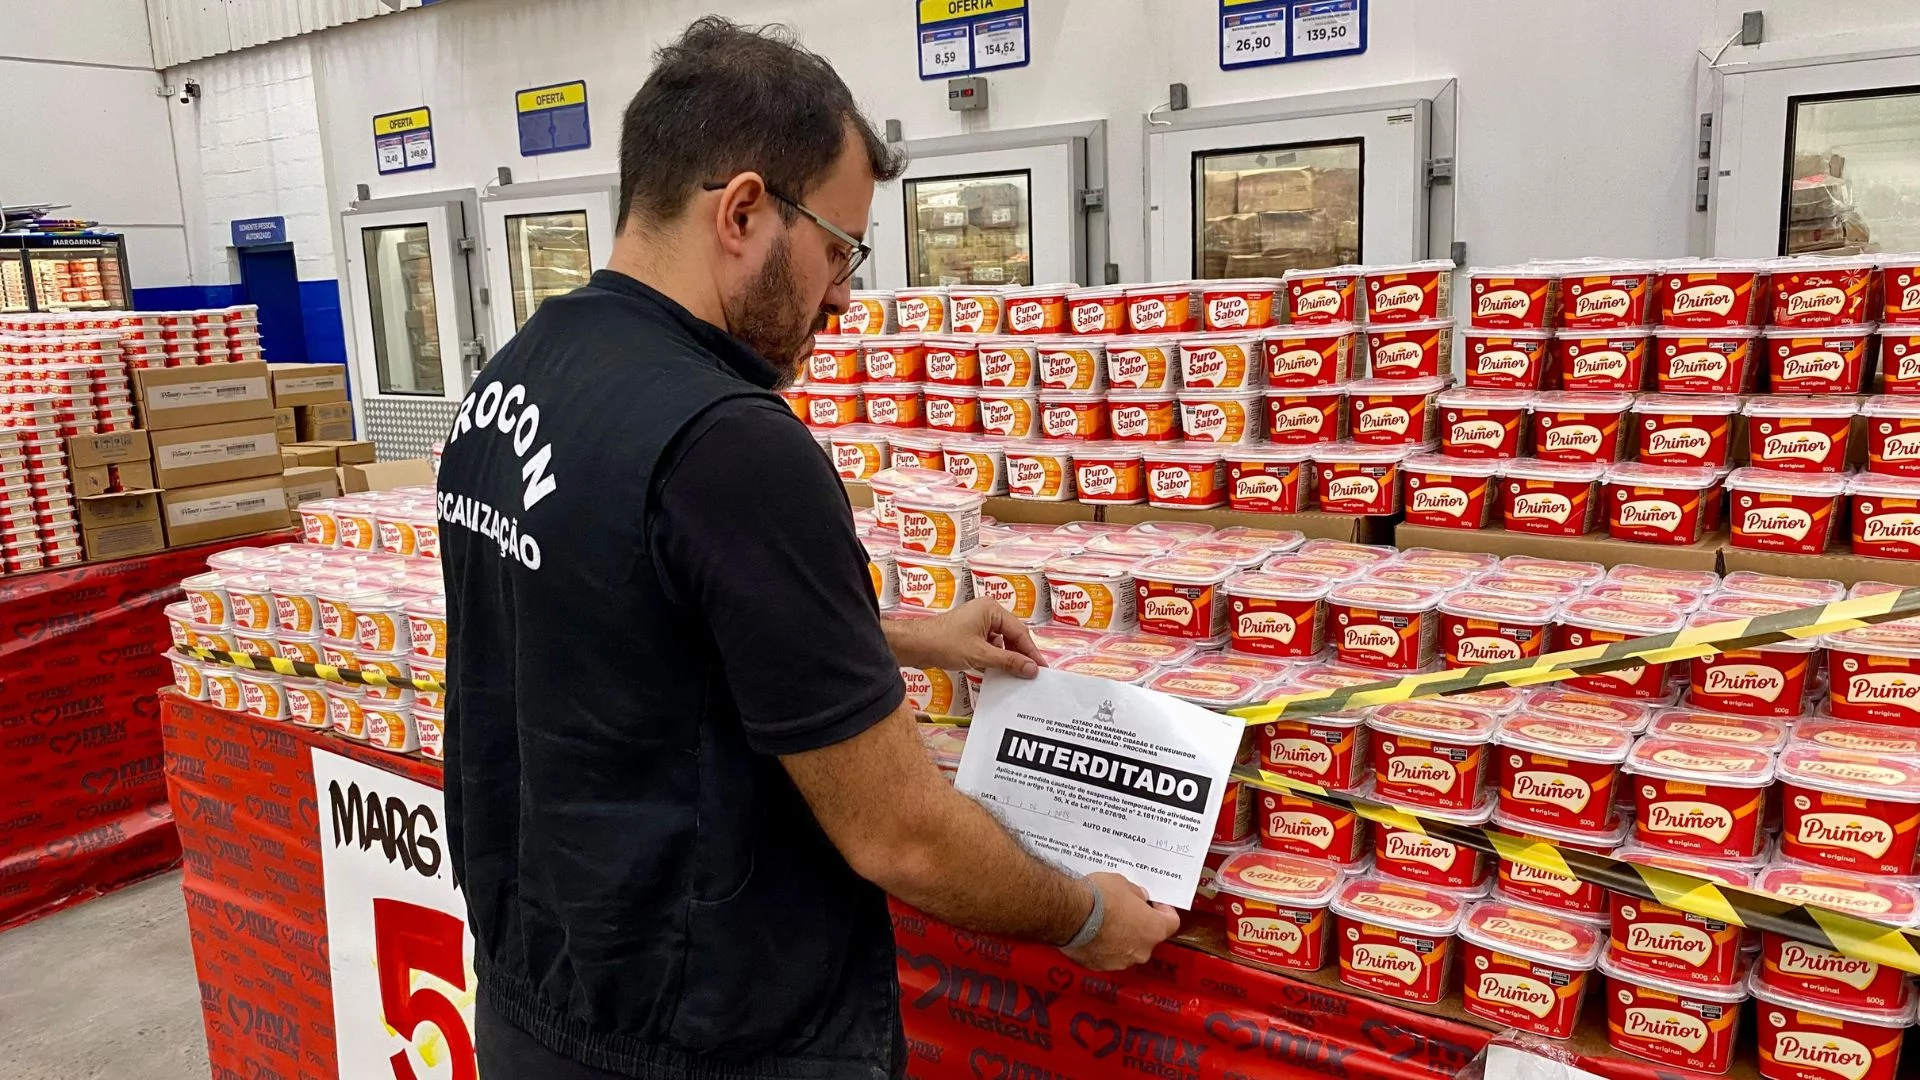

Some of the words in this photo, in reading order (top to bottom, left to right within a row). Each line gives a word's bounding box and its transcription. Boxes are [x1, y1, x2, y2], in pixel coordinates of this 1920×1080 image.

[948, 0, 993, 14] OFERTA
[1306, 26, 1346, 41] 139,50
[986, 42, 1014, 55] 154,62
[1236, 36, 1270, 52] 26,90
[935, 52, 956, 65] 8,59
[536, 92, 565, 106] OFERTA
[390, 117, 414, 129] OFERTA
[384, 154, 398, 164] 12,49
[410, 148, 428, 159] 249,80
[258, 222, 276, 230] PESSOAL
[52, 238, 101, 247] MARGARINAS
[246, 232, 272, 240] AUTORIZADO
[956, 302, 976, 312] Puro
[1215, 297, 1241, 310] Puro
[1677, 294, 1730, 309] Primor
[1791, 294, 1841, 310] Primor
[955, 309, 981, 322] Sabor
[1214, 306, 1248, 320] Sabor
[986, 354, 1006, 365] Puro
[1189, 350, 1216, 364] Puro
[985, 363, 1012, 375] Sabor
[1188, 360, 1222, 374] Sabor
[1277, 357, 1318, 373] Primor
[1672, 358, 1722, 374] Primor
[1118, 408, 1140, 420] Puro
[1278, 412, 1320, 428] Primor
[1118, 416, 1146, 428] Sabor
[1653, 434, 1706, 450] Primor
[838, 448, 858, 458] Puro
[838, 456, 863, 468] Sabor
[1157, 469, 1183, 482] Puro
[1156, 478, 1190, 491] Sabor
[1238, 482, 1278, 497] Primor
[1416, 494, 1464, 508] Primor
[904, 515, 926, 526] Puro
[1624, 506, 1676, 522] Primor
[1748, 512, 1806, 530] Primor
[418, 529, 431, 538] Puro
[903, 525, 934, 538] Sabor
[418, 537, 437, 546] Sabor
[1059, 589, 1084, 601] Puro
[232, 598, 246, 607] Puro
[1058, 598, 1090, 612] Sabor
[1145, 600, 1189, 618] Primor
[234, 606, 251, 616] Sabor
[412, 623, 427, 632] Puro
[1241, 618, 1291, 635] Primor
[413, 631, 432, 642] Sabor
[1462, 642, 1515, 660] Primor
[1710, 672, 1778, 690] Primor
[244, 685, 259, 694] Puro
[246, 693, 263, 703] Sabor
[1729, 700, 1754, 708] original
[1071, 718, 1093, 727] ESTADO
[1103, 725, 1136, 738] MARANHÃO
[1016, 712, 1044, 723] INSTITUTO
[1053, 720, 1084, 733] PROMOÇÃO
[1090, 729, 1111, 738] DEFESA
[1154, 744, 1195, 759] CONSUMIDOR
[1055, 727, 1076, 736] ESTADO
[1085, 734, 1118, 747] MARANHÃO
[1007, 736, 1199, 802] INTERDITADO
[1392, 760, 1450, 780] Primor
[1518, 776, 1584, 799] Primor
[995, 766, 1022, 777] Aplica-se
[1028, 774, 1049, 783] medida
[1050, 779, 1076, 790] cautelar
[1086, 789, 1120, 803] suspensão
[1120, 798, 1156, 813] temporária
[1166, 810, 1201, 824] atividades
[1026, 781, 1044, 791] artigo
[1077, 794, 1102, 805] Decreto
[1103, 801, 1127, 812] Federal
[1136, 810, 1172, 824] 2.181/1997
[1178, 821, 1199, 832] artigo
[1082, 821, 1100, 830] AUTO
[1111, 828, 1146, 843] INFRAÇÃO
[1273, 816, 1329, 837] Primor
[1804, 819, 1886, 843] Primor
[1025, 830, 1048, 842] Castelo
[1048, 837, 1070, 848] Branco,
[1091, 849, 1103, 857] São
[1103, 853, 1135, 867] Francisco,
[1135, 862, 1149, 871] CEP:
[1390, 837, 1450, 858] Primor
[1674, 838, 1701, 849] original
[1724, 849, 1740, 857] 500g
[1880, 865, 1898, 873] 500g
[1632, 928, 1706, 952] Primor
[1356, 948, 1416, 972] Primor
[1786, 946, 1870, 974] Primor
[950, 965, 1057, 1027] mix
[1484, 977, 1550, 1005] Primor
[1809, 985, 1840, 995] original
[1866, 996, 1885, 1006] 500g
[1504, 1009, 1530, 1020] original
[1534, 1024, 1550, 1032] 500g
[1628, 1012, 1701, 1040] Primor
[1126, 1025, 1207, 1069] mix
[1780, 1036, 1864, 1066] Primor
